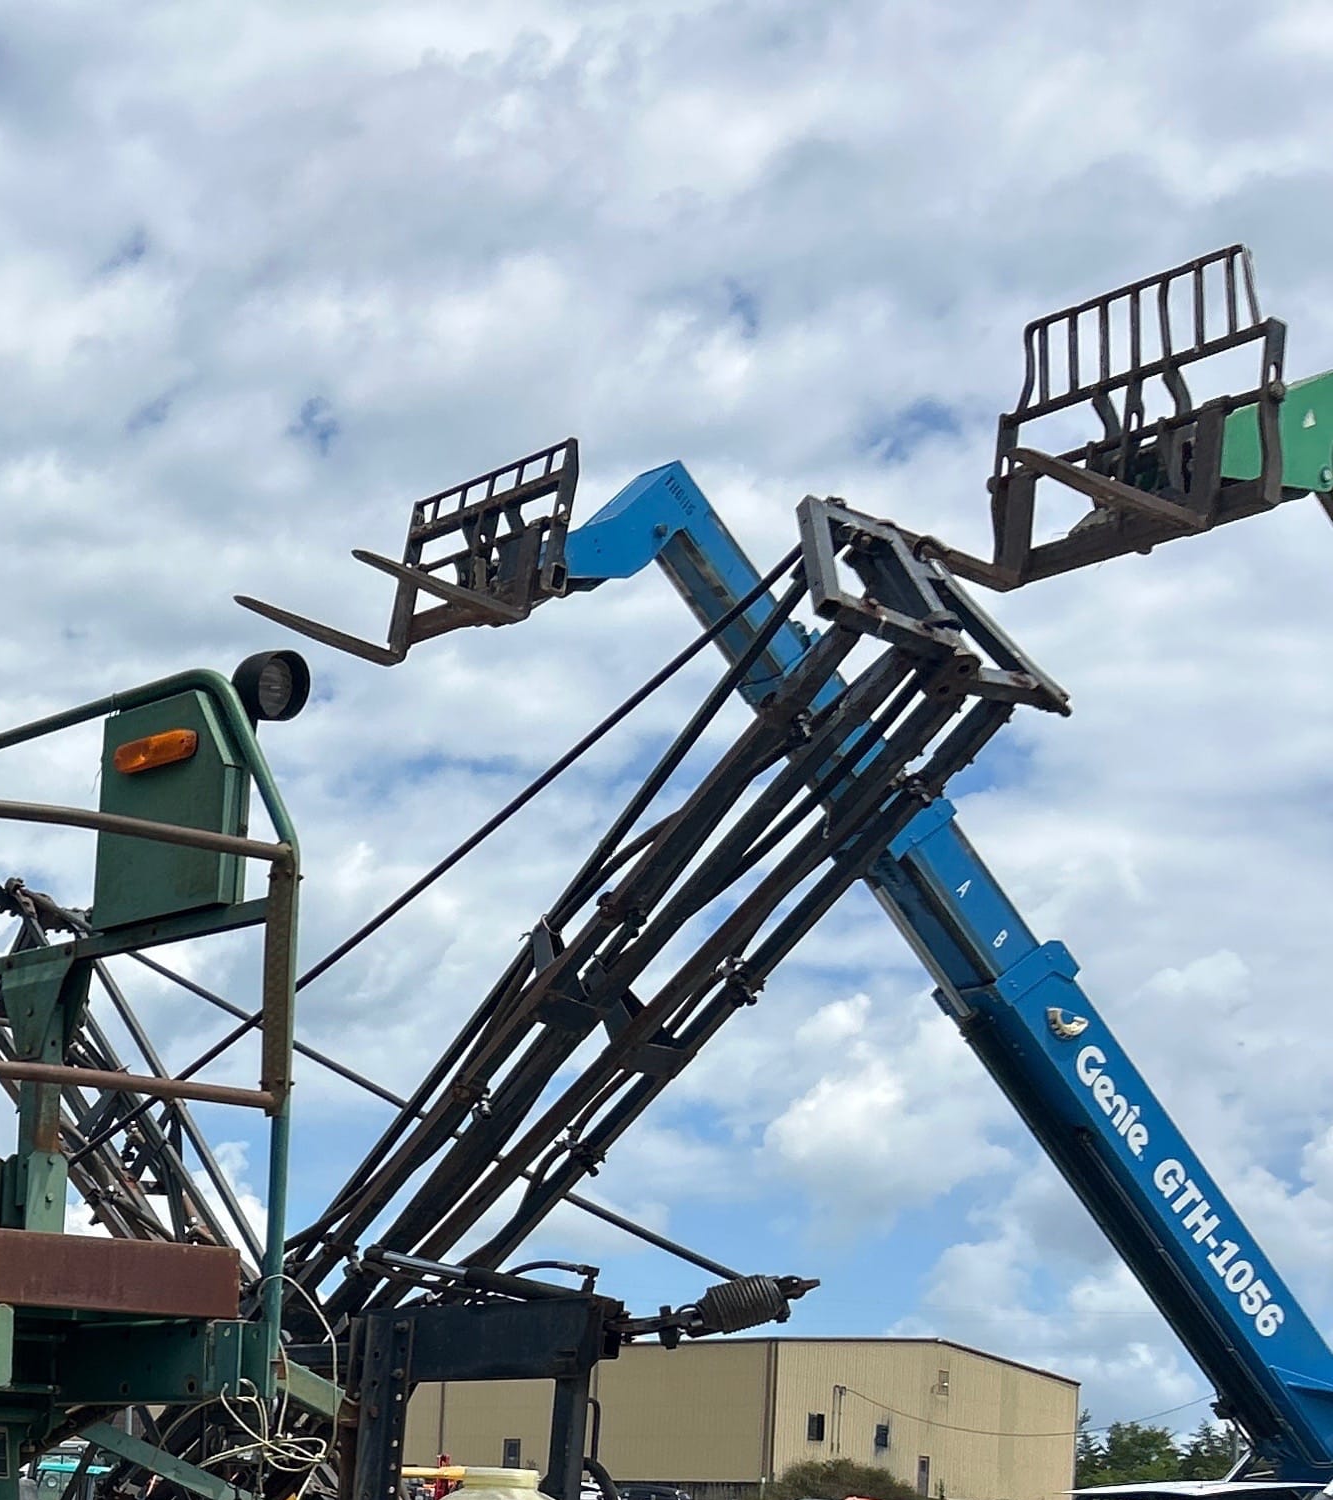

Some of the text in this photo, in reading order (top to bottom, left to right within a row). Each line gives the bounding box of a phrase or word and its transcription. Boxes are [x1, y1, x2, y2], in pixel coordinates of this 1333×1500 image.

[956, 880, 971, 898] A
[993, 930, 1008, 948] B
[1076, 1045, 1285, 1337] Genie GTH-1056
